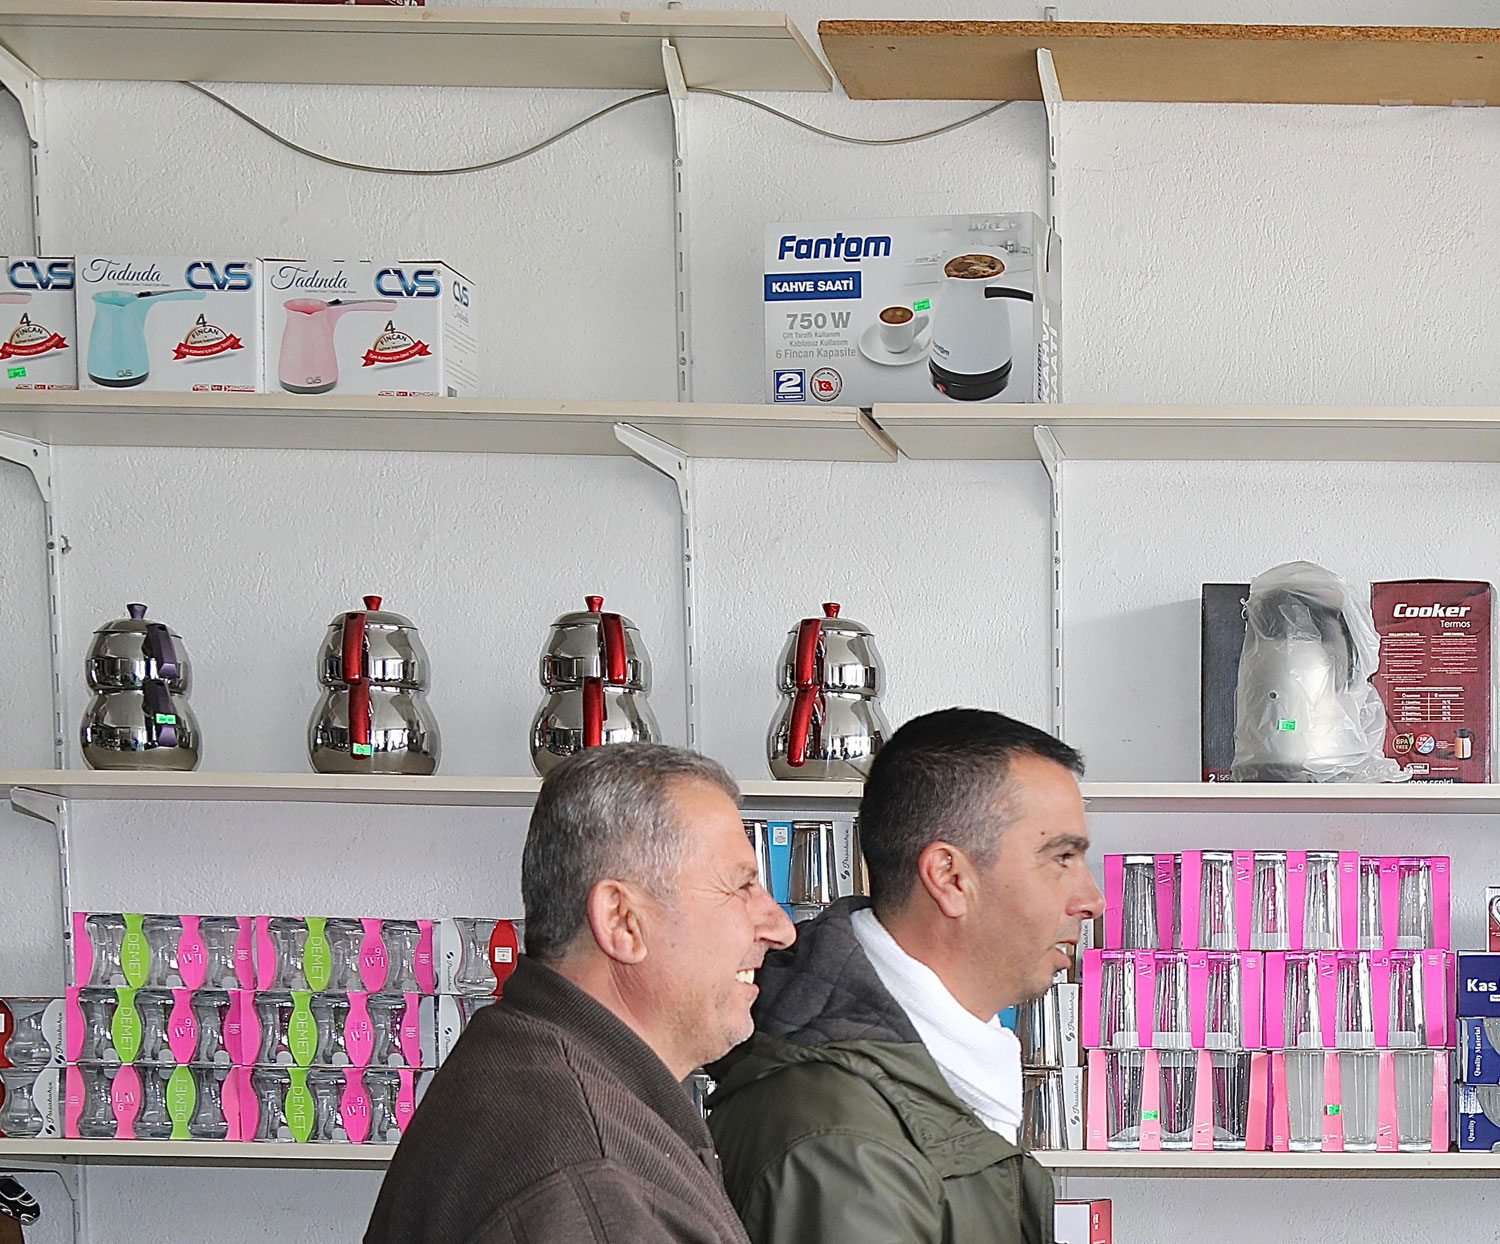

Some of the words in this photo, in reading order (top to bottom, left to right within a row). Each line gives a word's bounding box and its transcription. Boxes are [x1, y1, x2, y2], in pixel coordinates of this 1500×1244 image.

[777, 232, 892, 263] Fantom
[9, 261, 76, 290] CVS
[185, 261, 253, 291] CVS
[375, 269, 441, 297] CVS
[771, 280, 815, 293] KAHVE
[816, 276, 854, 292] SAATİ
[19, 312, 32, 327] 4
[195, 313, 208, 327] 4
[384, 319, 396, 333] 4
[786, 313, 827, 330] 750
[832, 311, 852, 329] W
[775, 350, 783, 359] 6
[784, 349, 815, 359] Fincan
[816, 348, 857, 360] Kapasite
[778, 372, 802, 393] 2
[1393, 603, 1471, 618] Cooker
[1440, 620, 1471, 629] Termos
[126, 932, 141, 979] DEMET
[311, 936, 324, 983] DEMET
[1466, 978, 1498, 992] Kas
[120, 1006, 134, 1052] DEMET
[296, 1010, 309, 1057] DEMET
[1473, 1055, 1482, 1076] Quality
[175, 1076, 188, 1123] DEMET
[292, 1086, 306, 1132] DEMET
